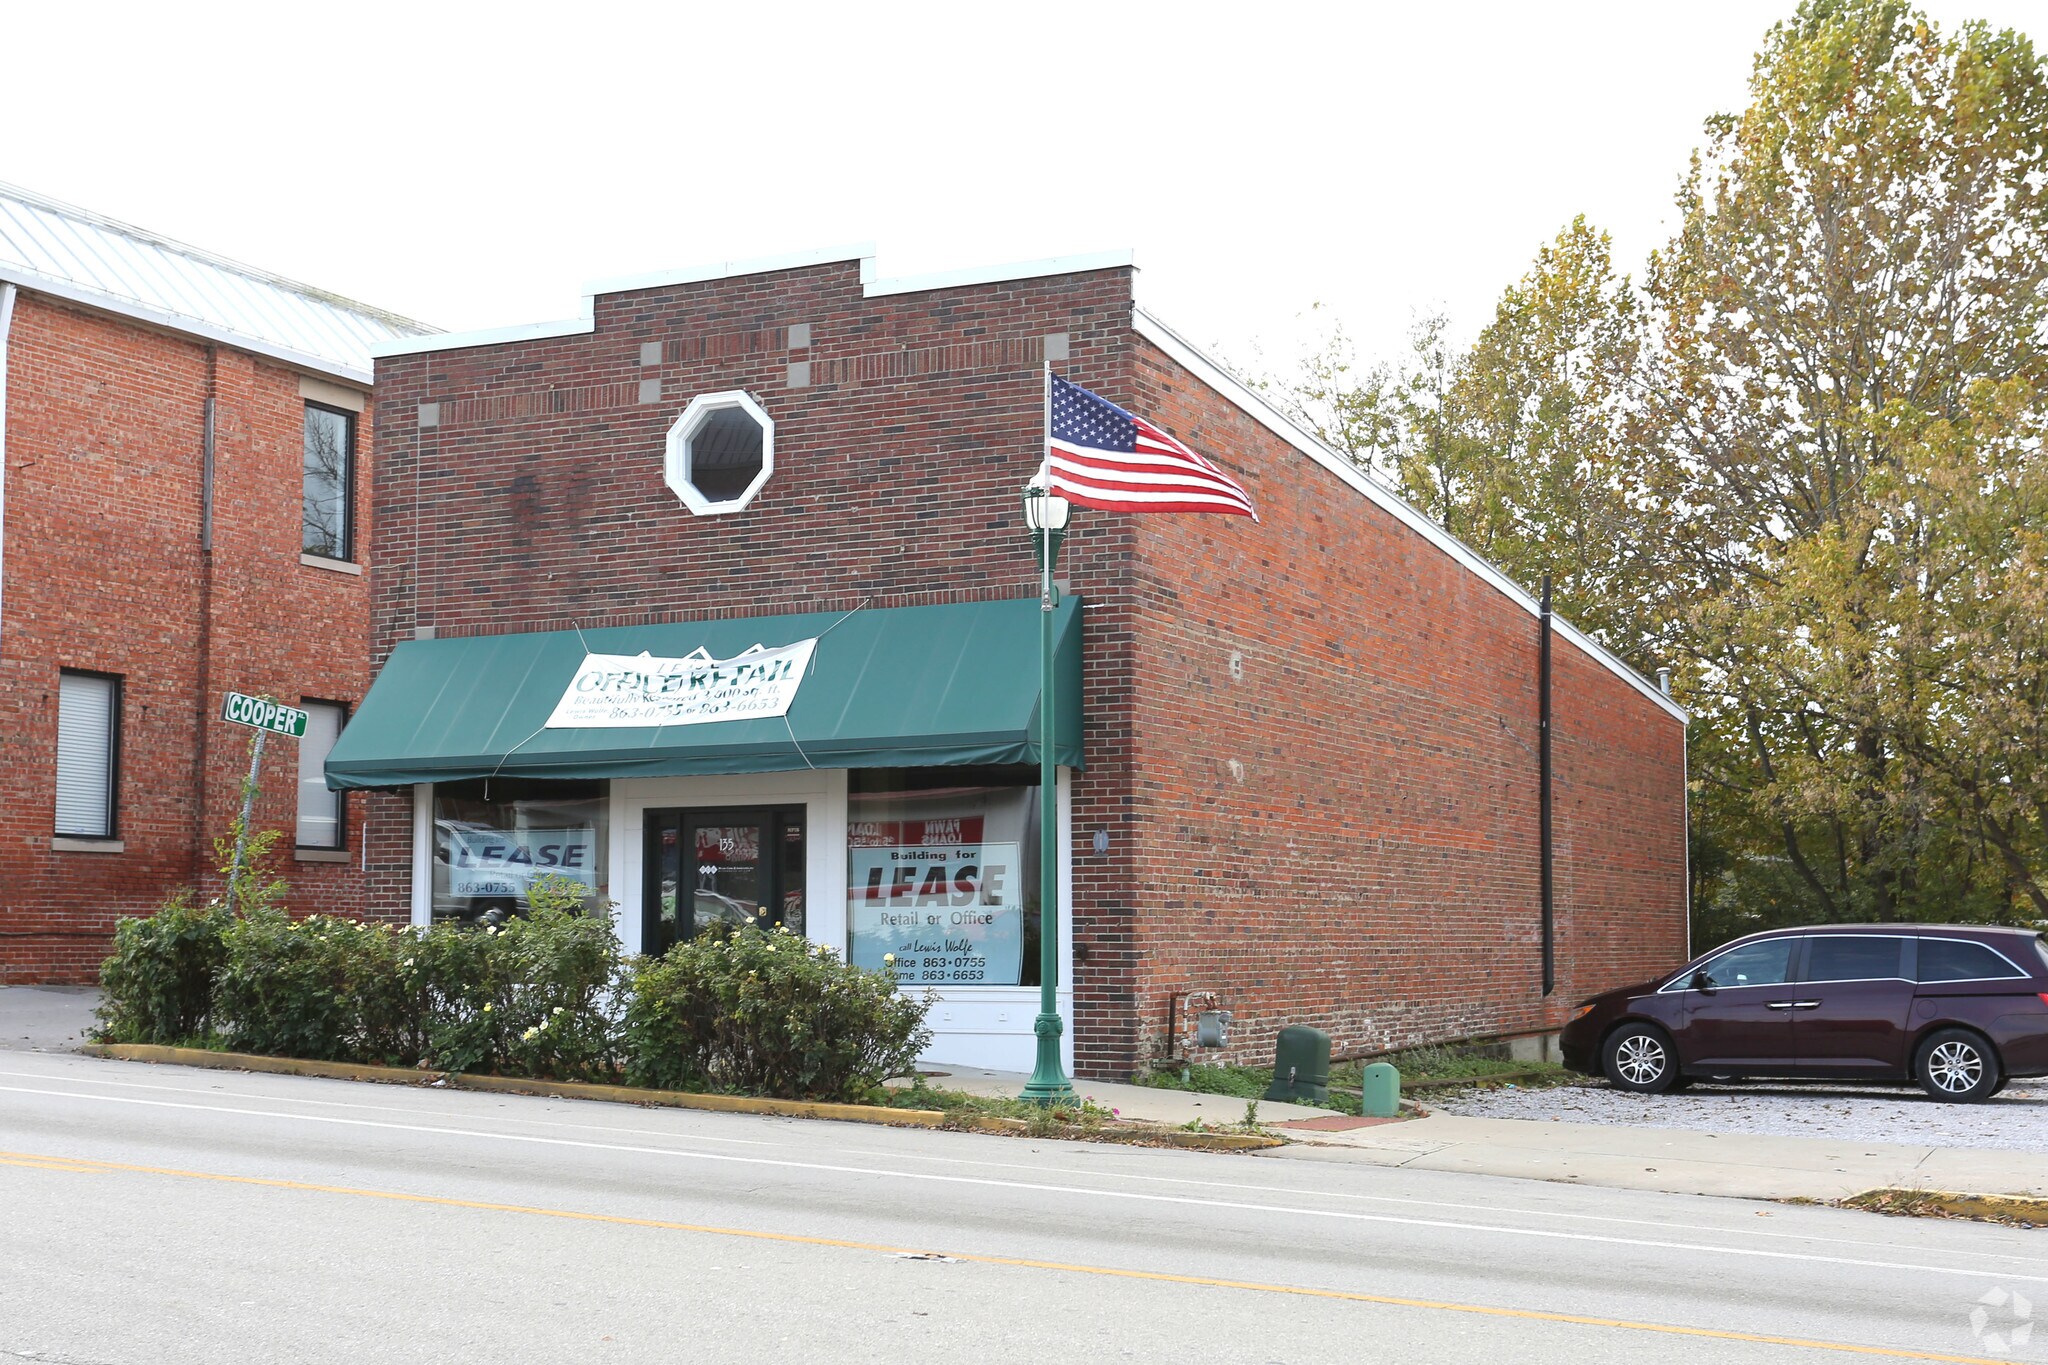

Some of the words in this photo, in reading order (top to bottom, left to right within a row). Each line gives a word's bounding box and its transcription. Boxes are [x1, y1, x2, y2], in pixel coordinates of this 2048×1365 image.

[229, 695, 297, 734] COOPER
[608, 703, 684, 719] 863-0755
[699, 697, 780, 714] 863-6653
[719, 838, 734, 851] 135
[456, 844, 588, 868] LEASE
[891, 851, 947, 861] Building
[955, 850, 977, 859] for
[457, 881, 516, 893] 863-0755
[864, 865, 1007, 907] LEASE
[881, 912, 918, 926] Retail
[927, 914, 941, 926] or
[950, 911, 993, 926] Office
[899, 943, 912, 952] call
[913, 939, 941, 953] Lewis
[944, 938, 973, 957] Wolfe
